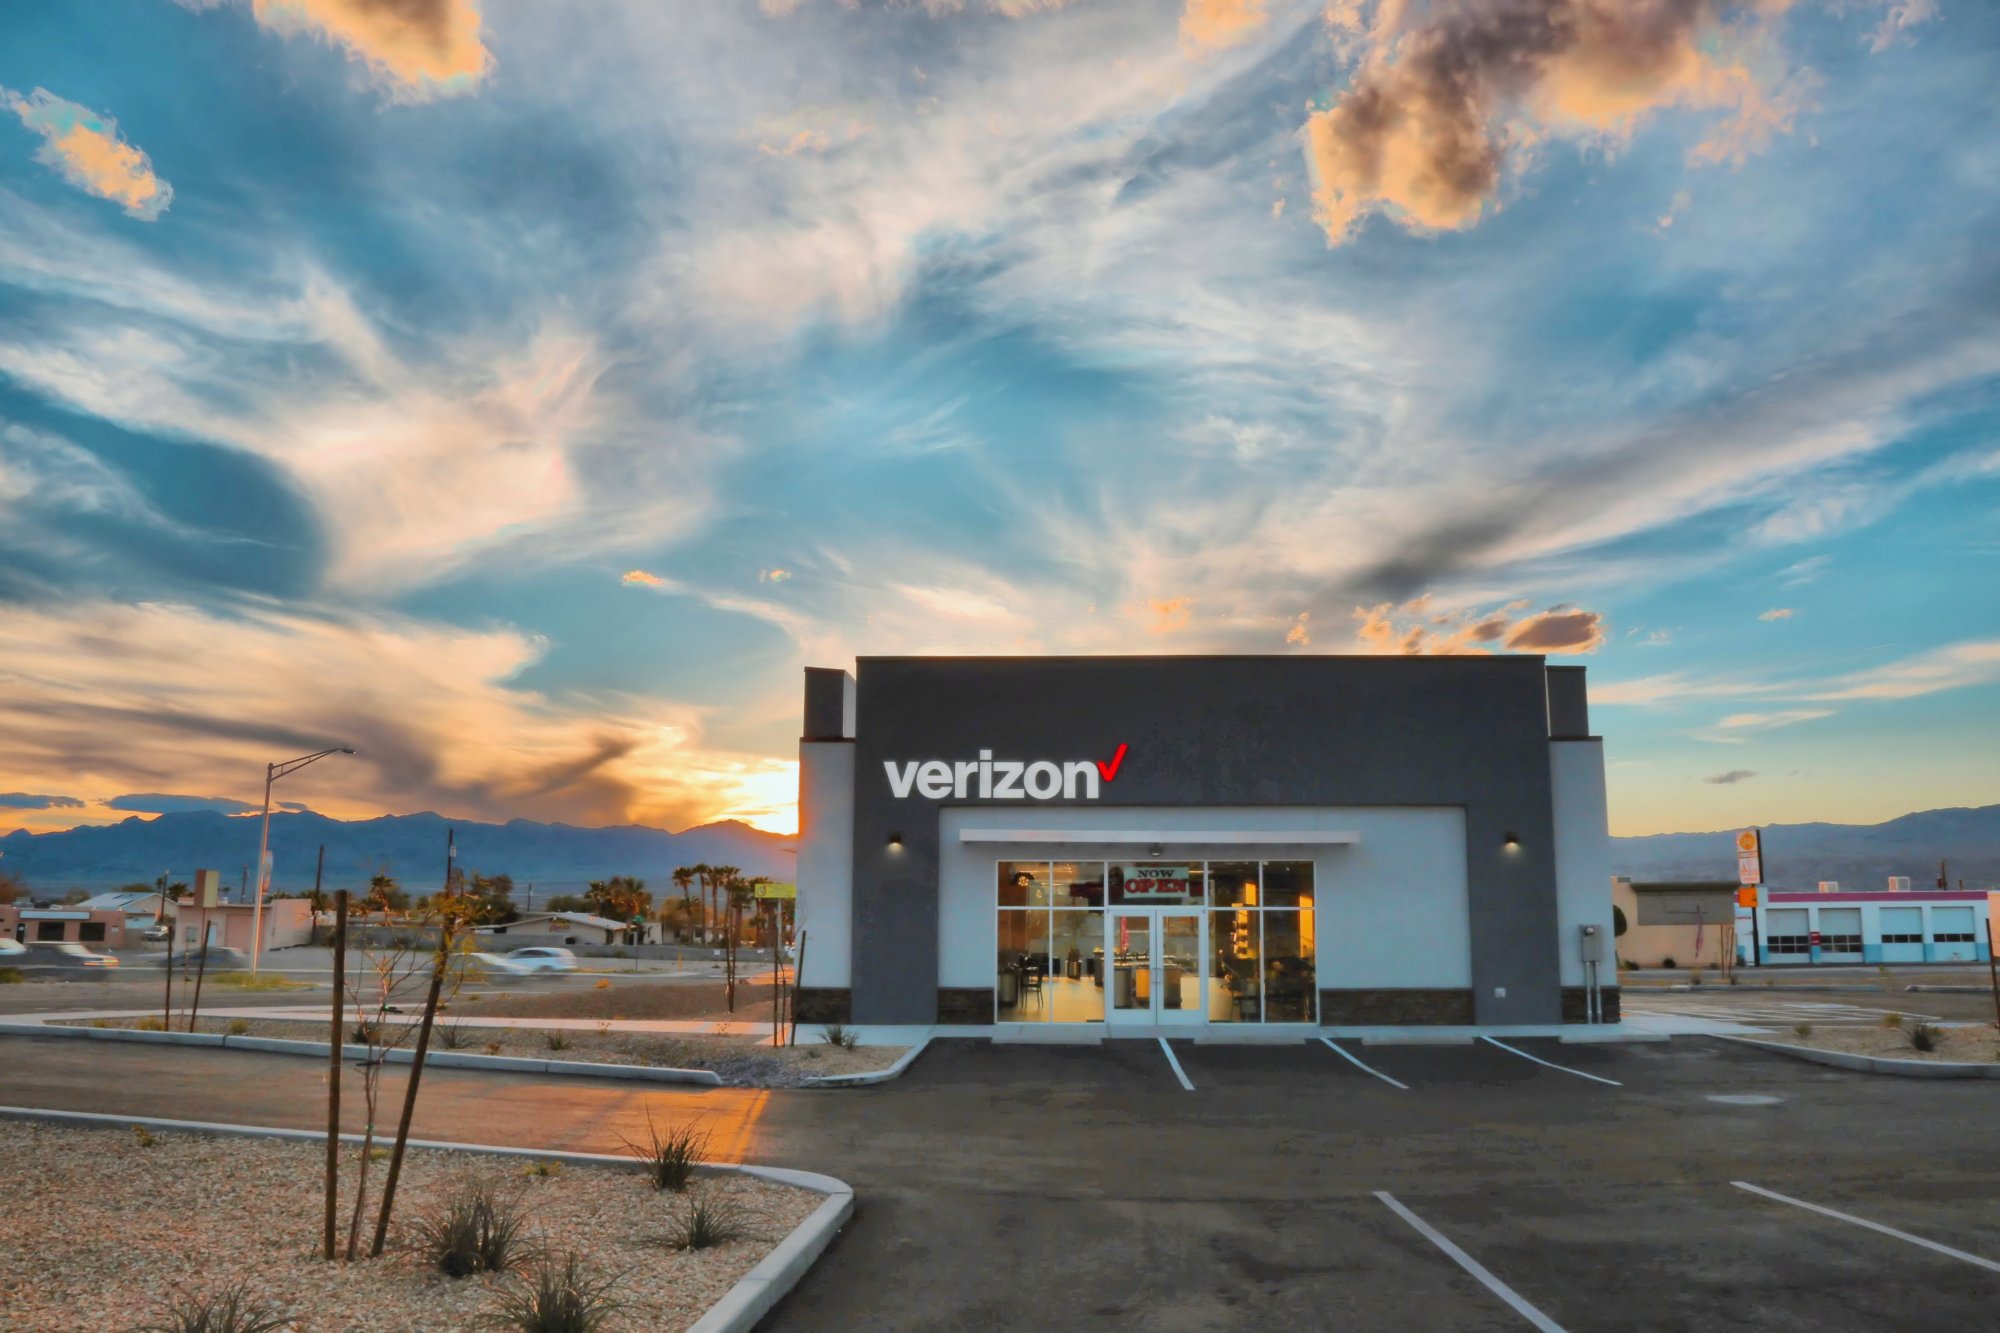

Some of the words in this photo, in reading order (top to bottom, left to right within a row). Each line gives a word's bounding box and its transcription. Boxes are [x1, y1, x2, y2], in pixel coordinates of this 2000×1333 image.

[883, 749, 1100, 800] verizon
[1137, 869, 1175, 878] NOW
[1124, 878, 1186, 894] OPEN
